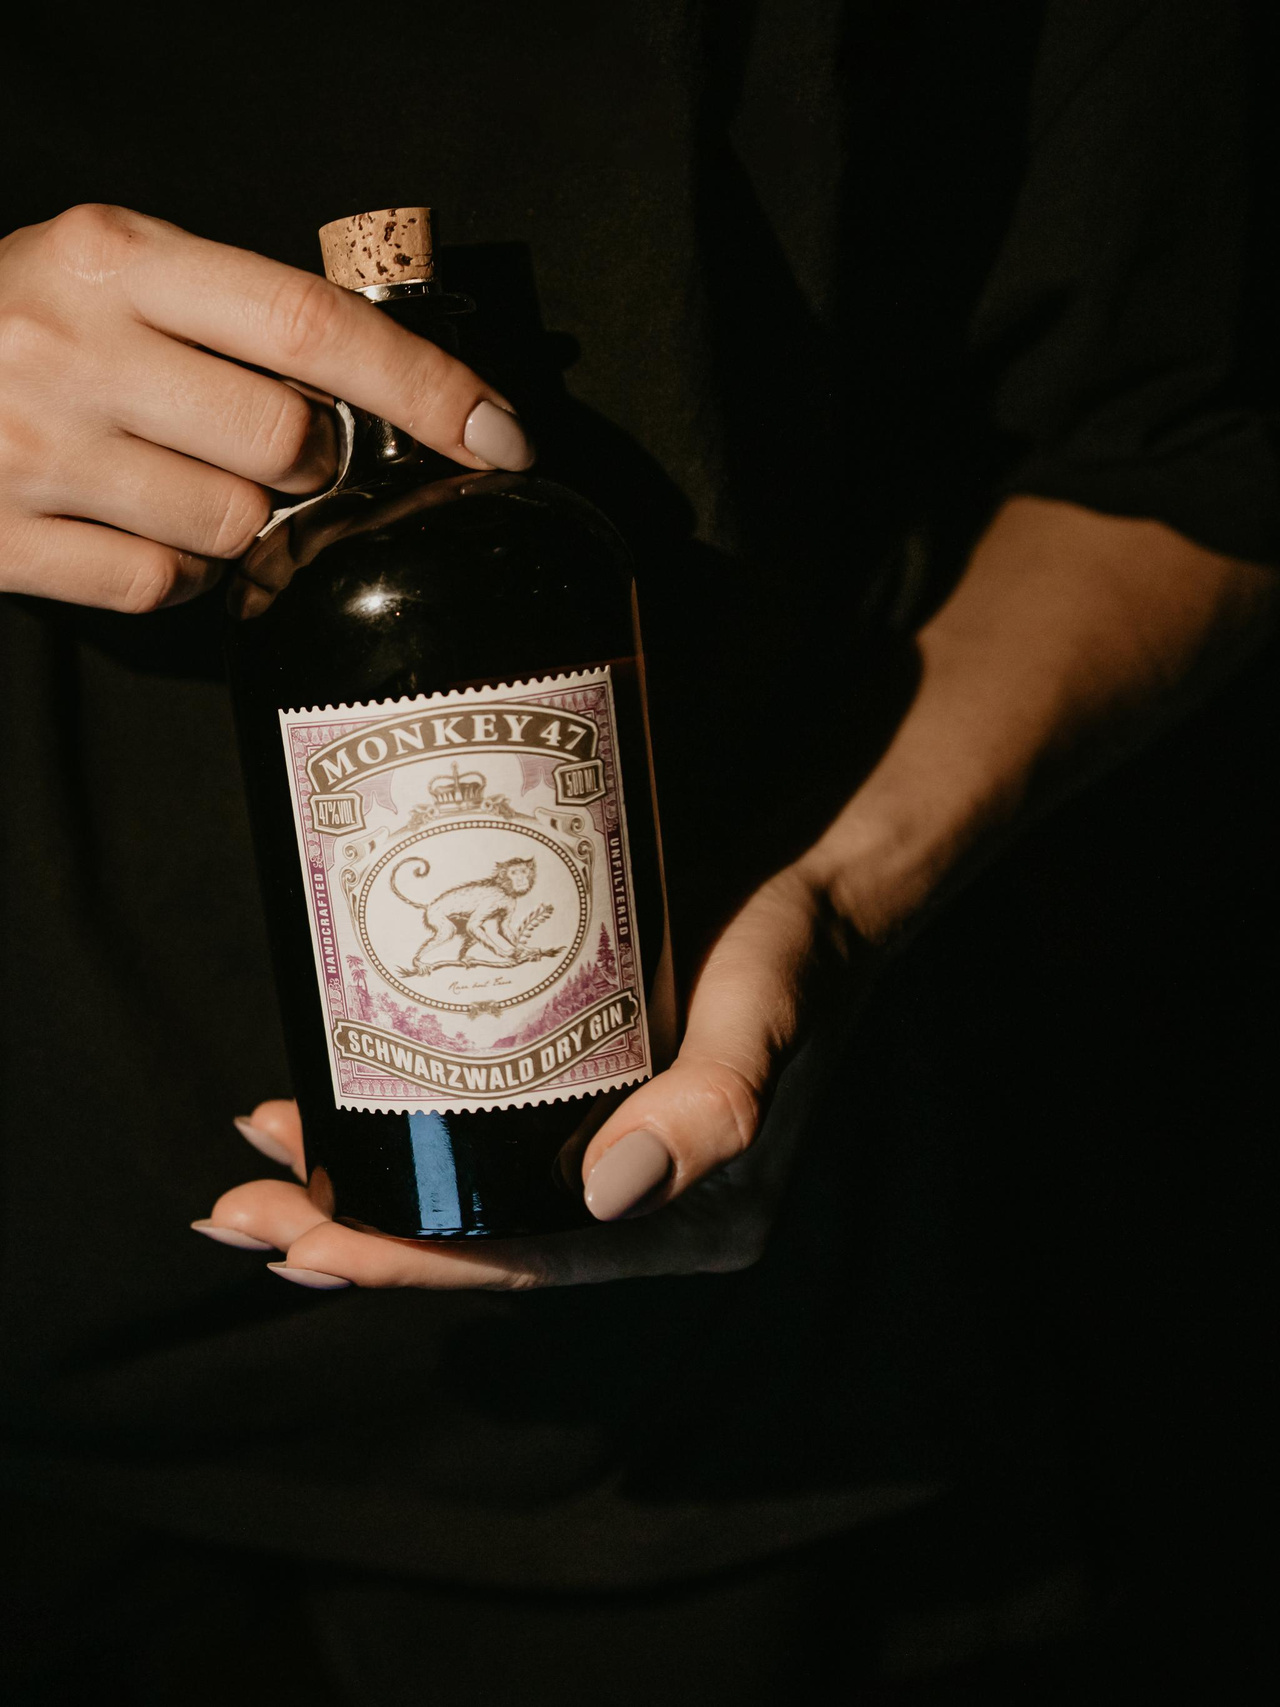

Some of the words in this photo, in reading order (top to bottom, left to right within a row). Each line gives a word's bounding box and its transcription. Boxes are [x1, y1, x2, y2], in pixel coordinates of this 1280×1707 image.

[318, 714, 533, 785] MONKEY
[540, 721, 587, 750] 47
[313, 872, 337, 974] HANDCRAFTED
[609, 837, 629, 936] UNFILTERED
[348, 1030, 534, 1091] SCHWARZWALD
[541, 1025, 586, 1073] DRY
[589, 1002, 624, 1041] GIN
